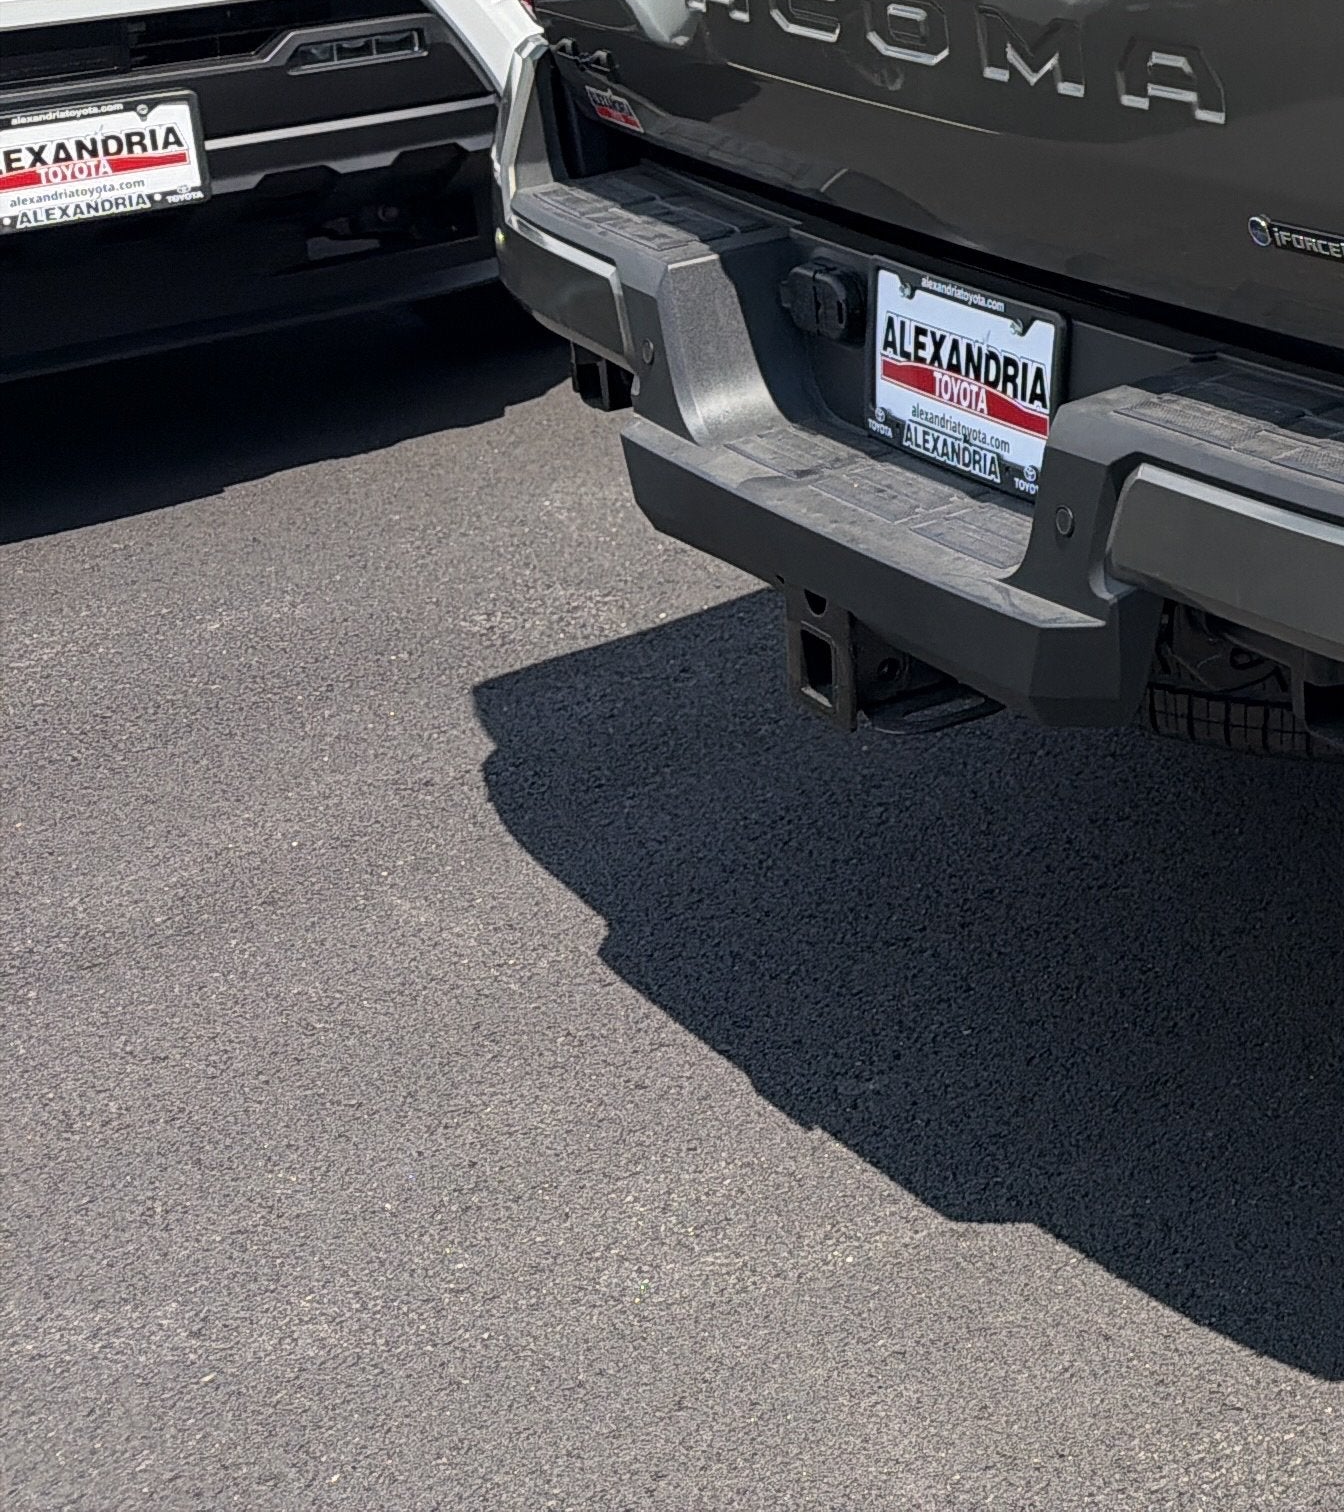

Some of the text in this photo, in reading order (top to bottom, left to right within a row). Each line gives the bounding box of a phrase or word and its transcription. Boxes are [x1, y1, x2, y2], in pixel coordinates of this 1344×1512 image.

[11, 103, 124, 126] alexandriatoyota.com
[0, 125, 184, 176] EXANDRIA
[36, 159, 113, 185] TOYOTA
[9, 178, 146, 208] alexandriatoyota.com
[17, 193, 151, 227] ALEXANDRIA
[166, 191, 205, 204] TOYOTA
[921, 276, 1005, 313] alexandriatoyota.com
[882, 315, 1049, 410] ALEXANDRIA
[933, 371, 989, 415] TOYOTA
[868, 418, 894, 439] TOYOTA
[911, 403, 1011, 455] alexandriatoyota.com
[903, 424, 1001, 482] ALEXANDRIA
